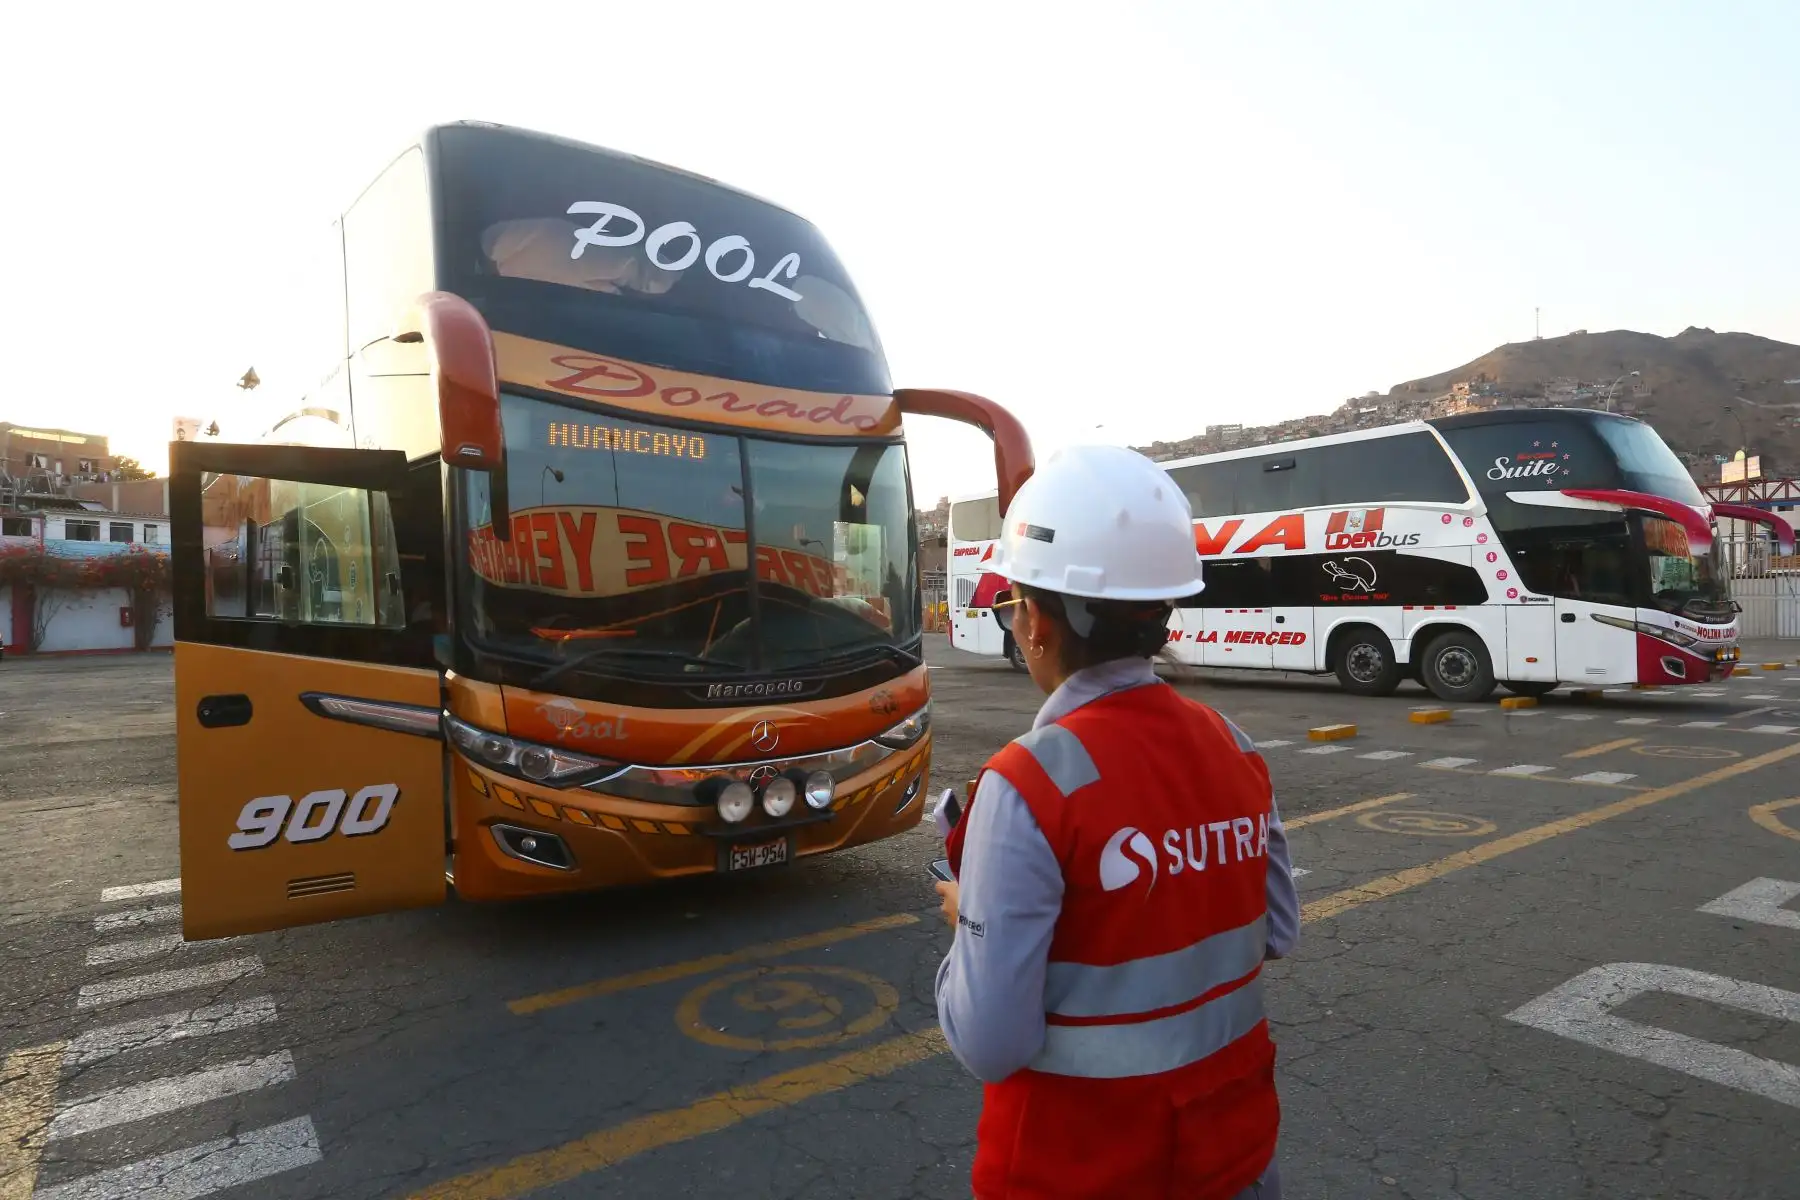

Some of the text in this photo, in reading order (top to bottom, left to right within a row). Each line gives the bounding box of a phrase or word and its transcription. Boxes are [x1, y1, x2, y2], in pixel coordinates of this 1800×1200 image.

[566, 201, 803, 302] POOL
[546, 354, 878, 431] Dorado
[550, 422, 705, 459] HUANCAYO
[1487, 456, 1560, 480] Suite
[954, 547, 980, 556] EMPRESA
[1196, 631, 1217, 643] LA
[1224, 631, 1306, 645] MERCED
[707, 680, 803, 699] Marcopolo
[228, 784, 400, 851] 900
[732, 844, 785, 869] F5W-954
[1163, 812, 1271, 875] SUTRA
